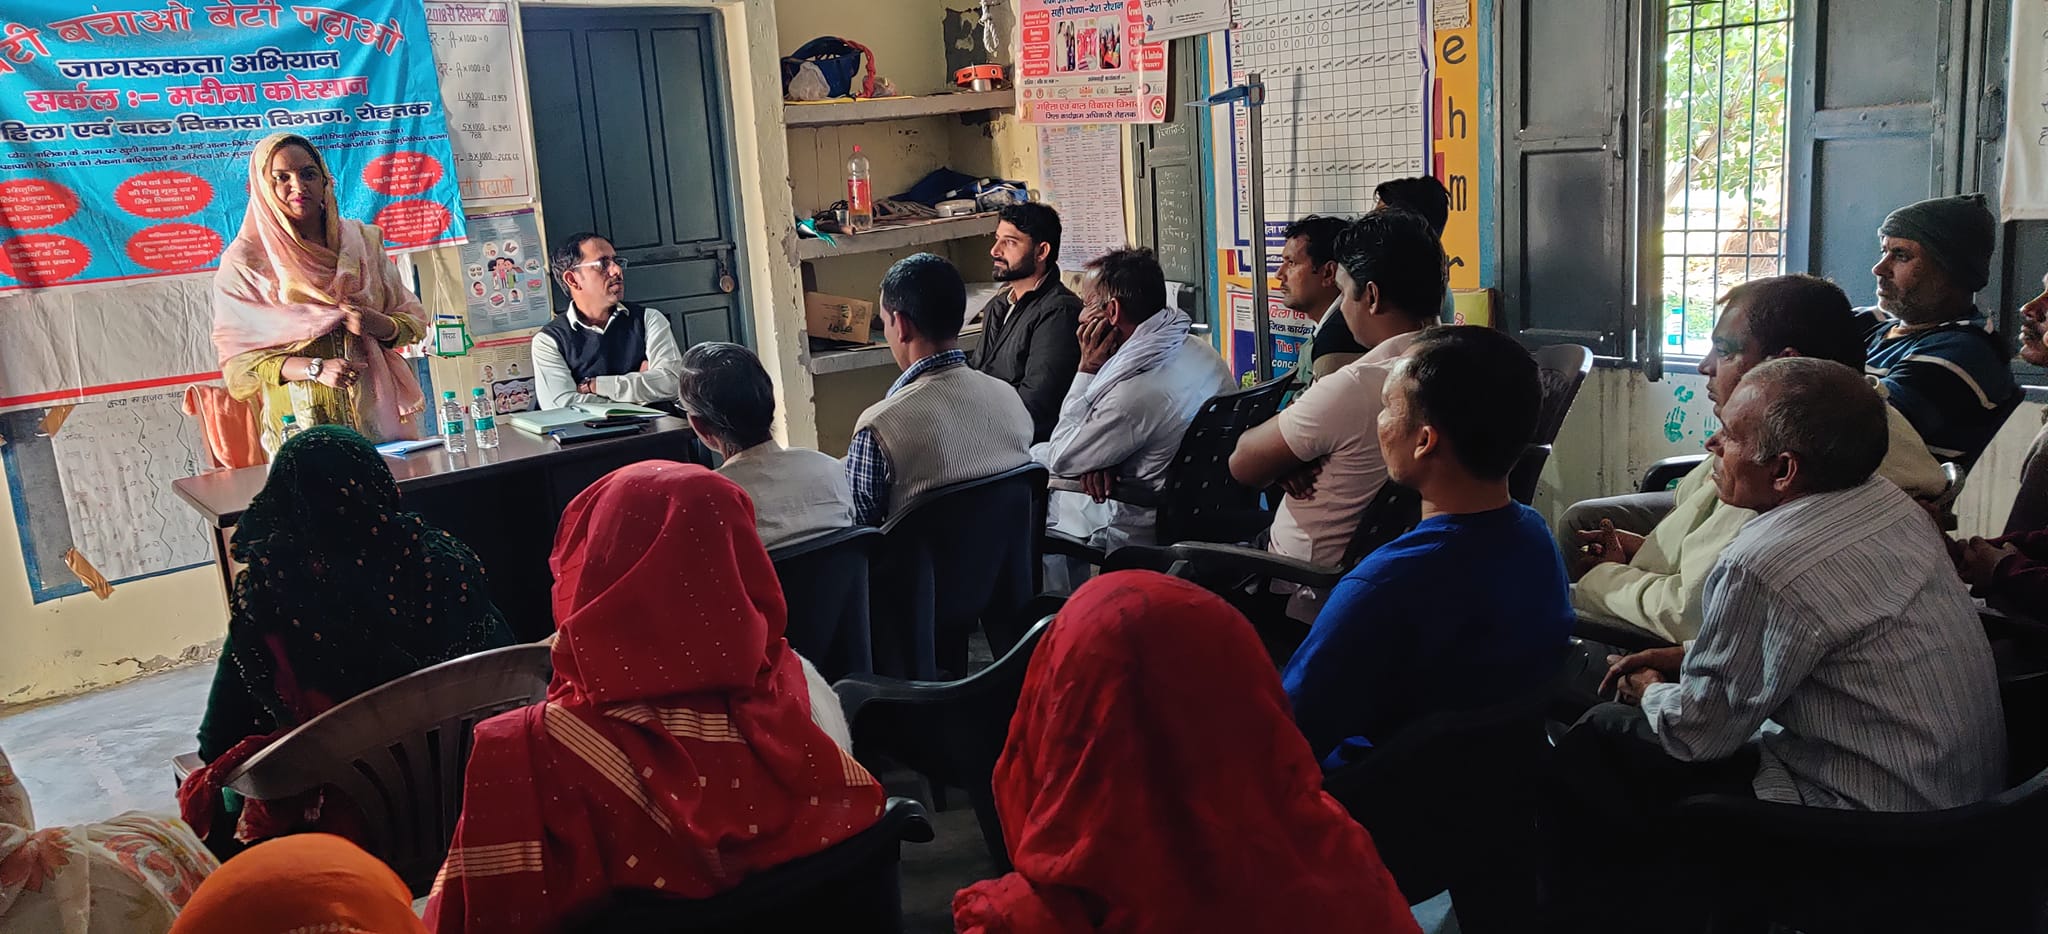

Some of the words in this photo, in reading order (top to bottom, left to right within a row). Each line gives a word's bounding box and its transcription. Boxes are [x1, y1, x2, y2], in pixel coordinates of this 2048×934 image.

[48, 1, 193, 42] बचाओ
[291, 6, 404, 55] पढ़ाओ
[57, 56, 224, 78] जागरूकता
[231, 48, 338, 72] अभियान
[1443, 35, 1467, 64] e
[25, 82, 119, 111] सर्कल
[167, 77, 256, 105] मदीना
[0, 120, 65, 141] हिला
[71, 118, 113, 136] एवं
[117, 120, 172, 135] बाल
[176, 114, 261, 132] विकास
[356, 102, 431, 120] रोहतक
[1449, 95, 1467, 139] h
[1450, 174, 1467, 212] m
[1276, 340, 1293, 353] The
